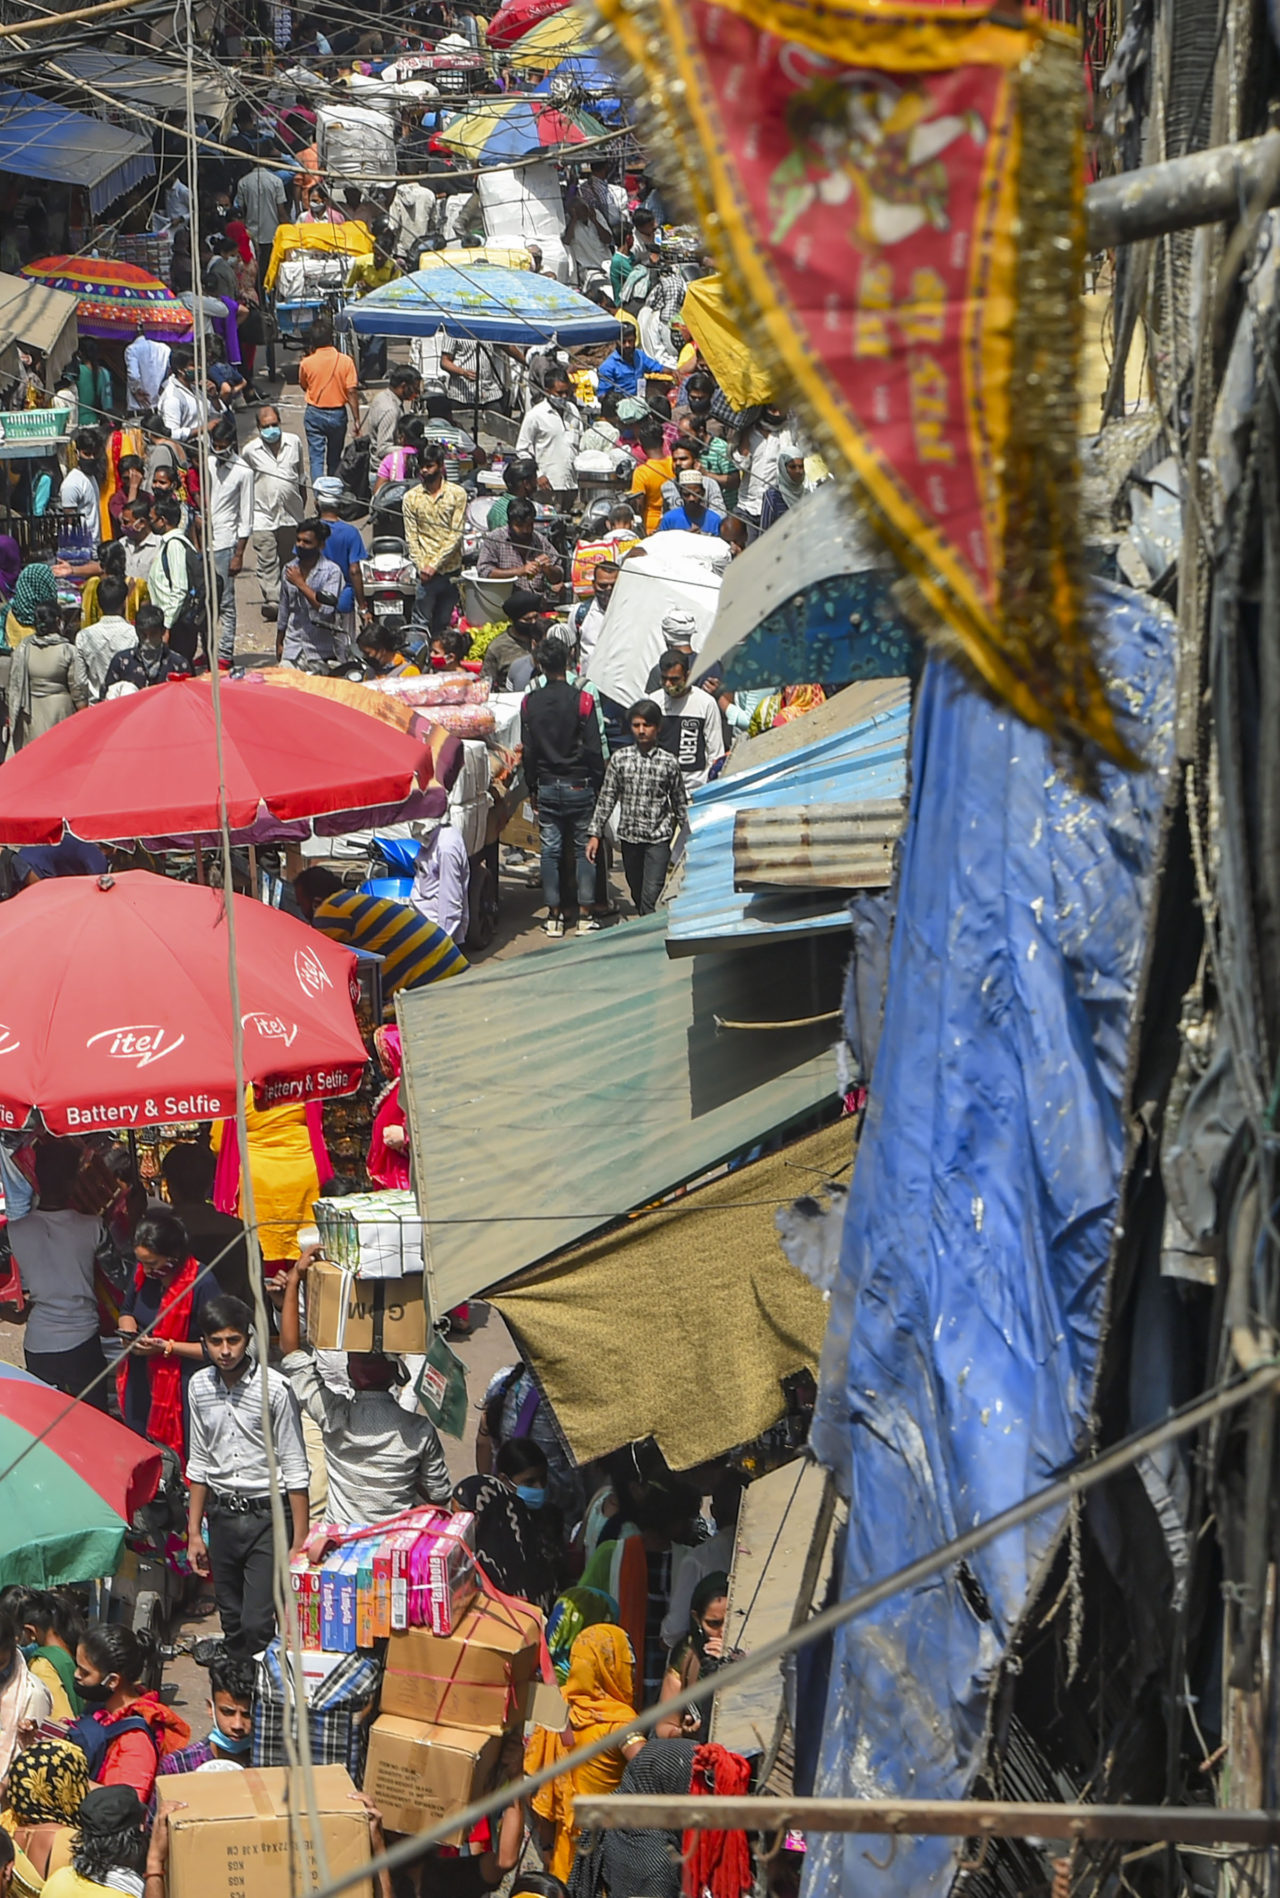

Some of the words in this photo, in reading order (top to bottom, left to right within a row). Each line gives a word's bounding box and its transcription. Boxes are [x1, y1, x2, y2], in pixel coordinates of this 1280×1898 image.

[317, 1069, 349, 1090] Selfie
[67, 1101, 139, 1126] Battery
[144, 1099, 160, 1117] &
[164, 1094, 221, 1116] Selfie
[226, 1845, 239, 1856] CM
[228, 1861, 244, 1871] KGS
[228, 1876, 245, 1887] KGS
